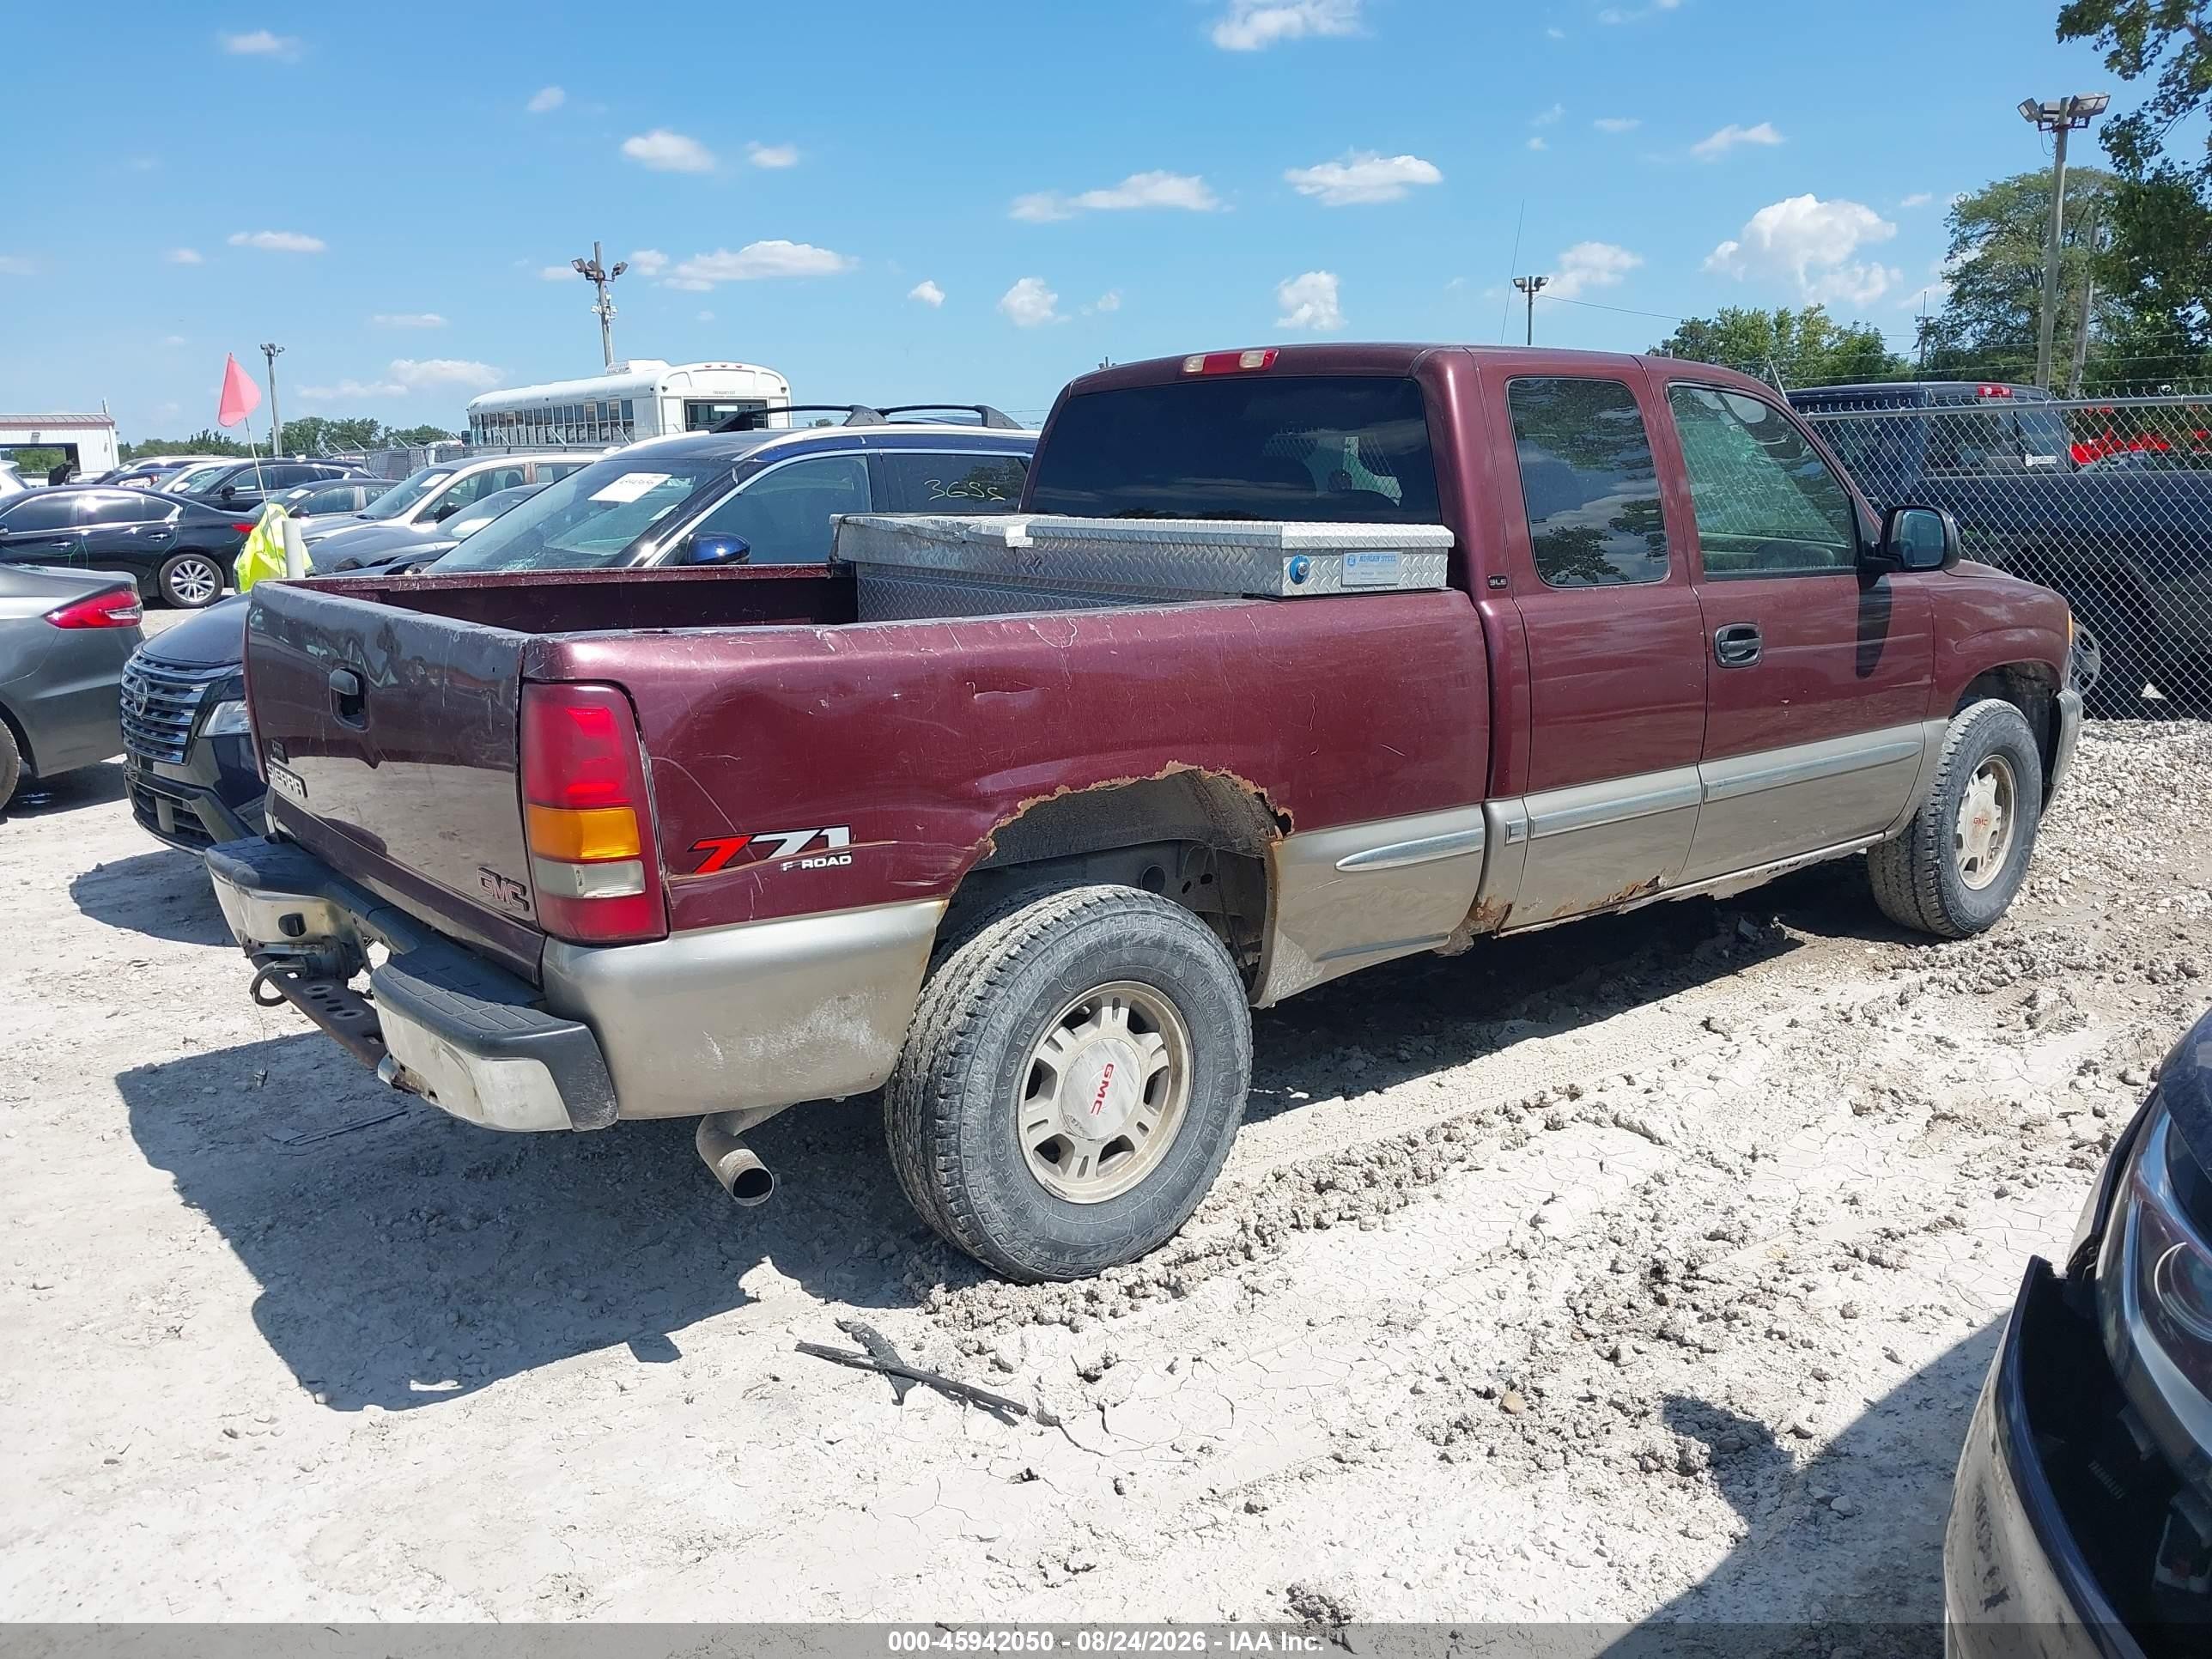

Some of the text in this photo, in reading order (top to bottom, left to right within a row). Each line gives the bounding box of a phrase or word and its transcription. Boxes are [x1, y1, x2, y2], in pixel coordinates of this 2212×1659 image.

[265, 762, 304, 798] SIERRA
[1973, 817, 1989, 826] GMC
[801, 854, 852, 869] ROAD
[477, 867, 529, 911] GMC
[1091, 1063, 1115, 1115] GMC
